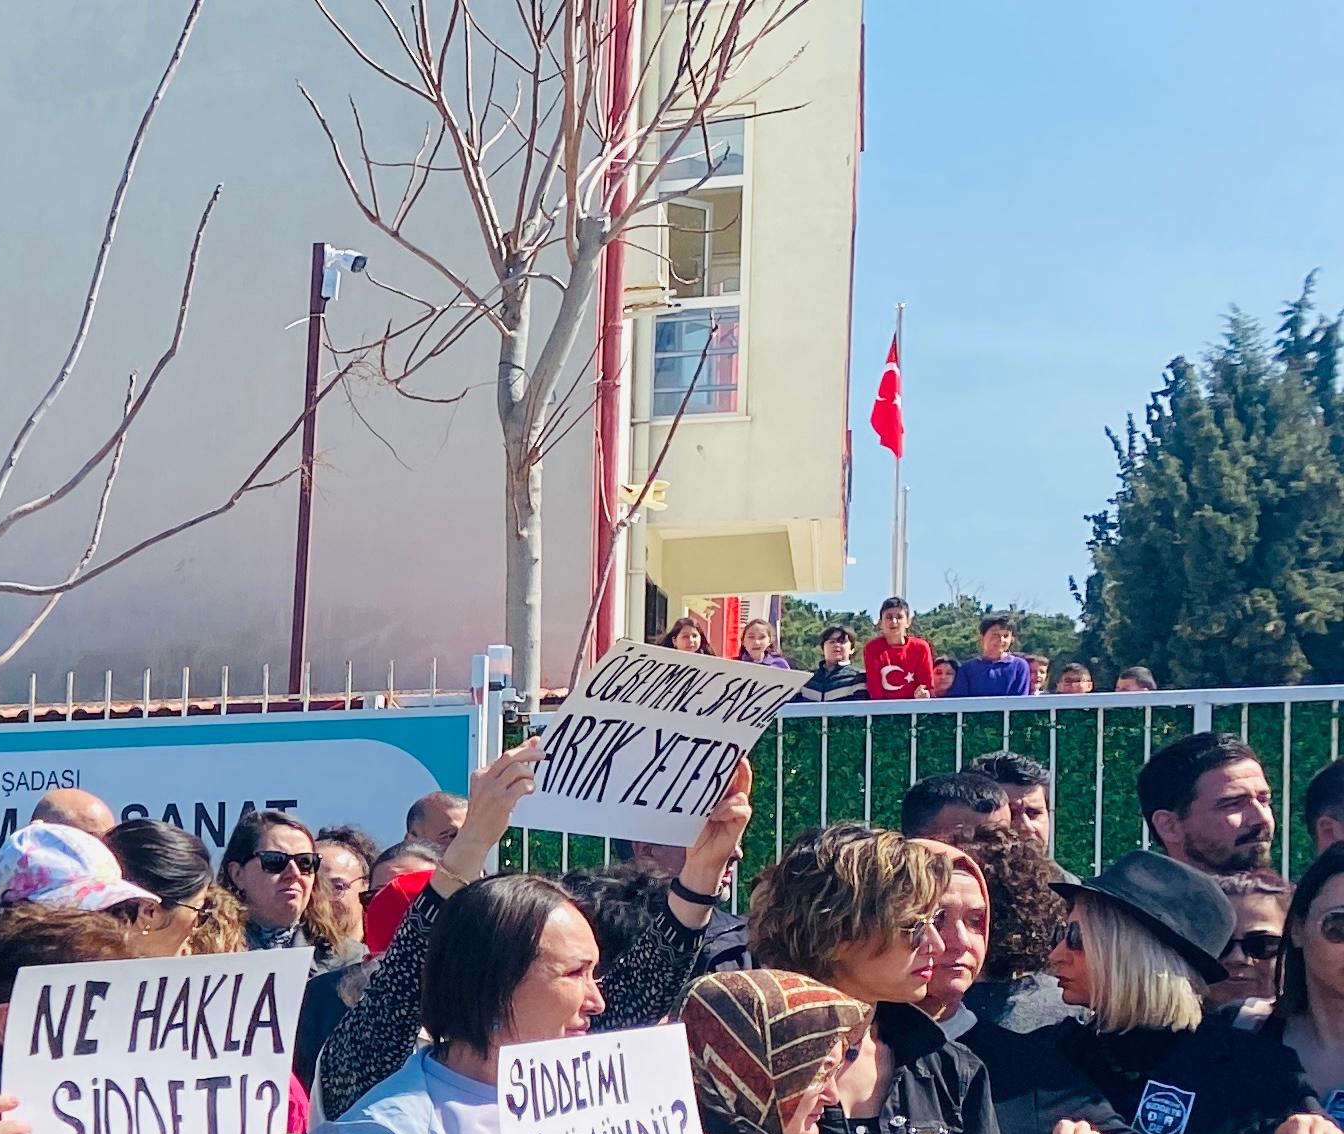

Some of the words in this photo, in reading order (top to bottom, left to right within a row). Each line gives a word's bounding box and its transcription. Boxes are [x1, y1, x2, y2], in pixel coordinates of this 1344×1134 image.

[585, 646, 725, 712] ÖĞRETMENE
[534, 714, 646, 803] ARTIK
[29, 981, 110, 1059] NE
[127, 973, 285, 1060] HAKLA
[506, 1042, 629, 1121] ŞİDDETMİ
